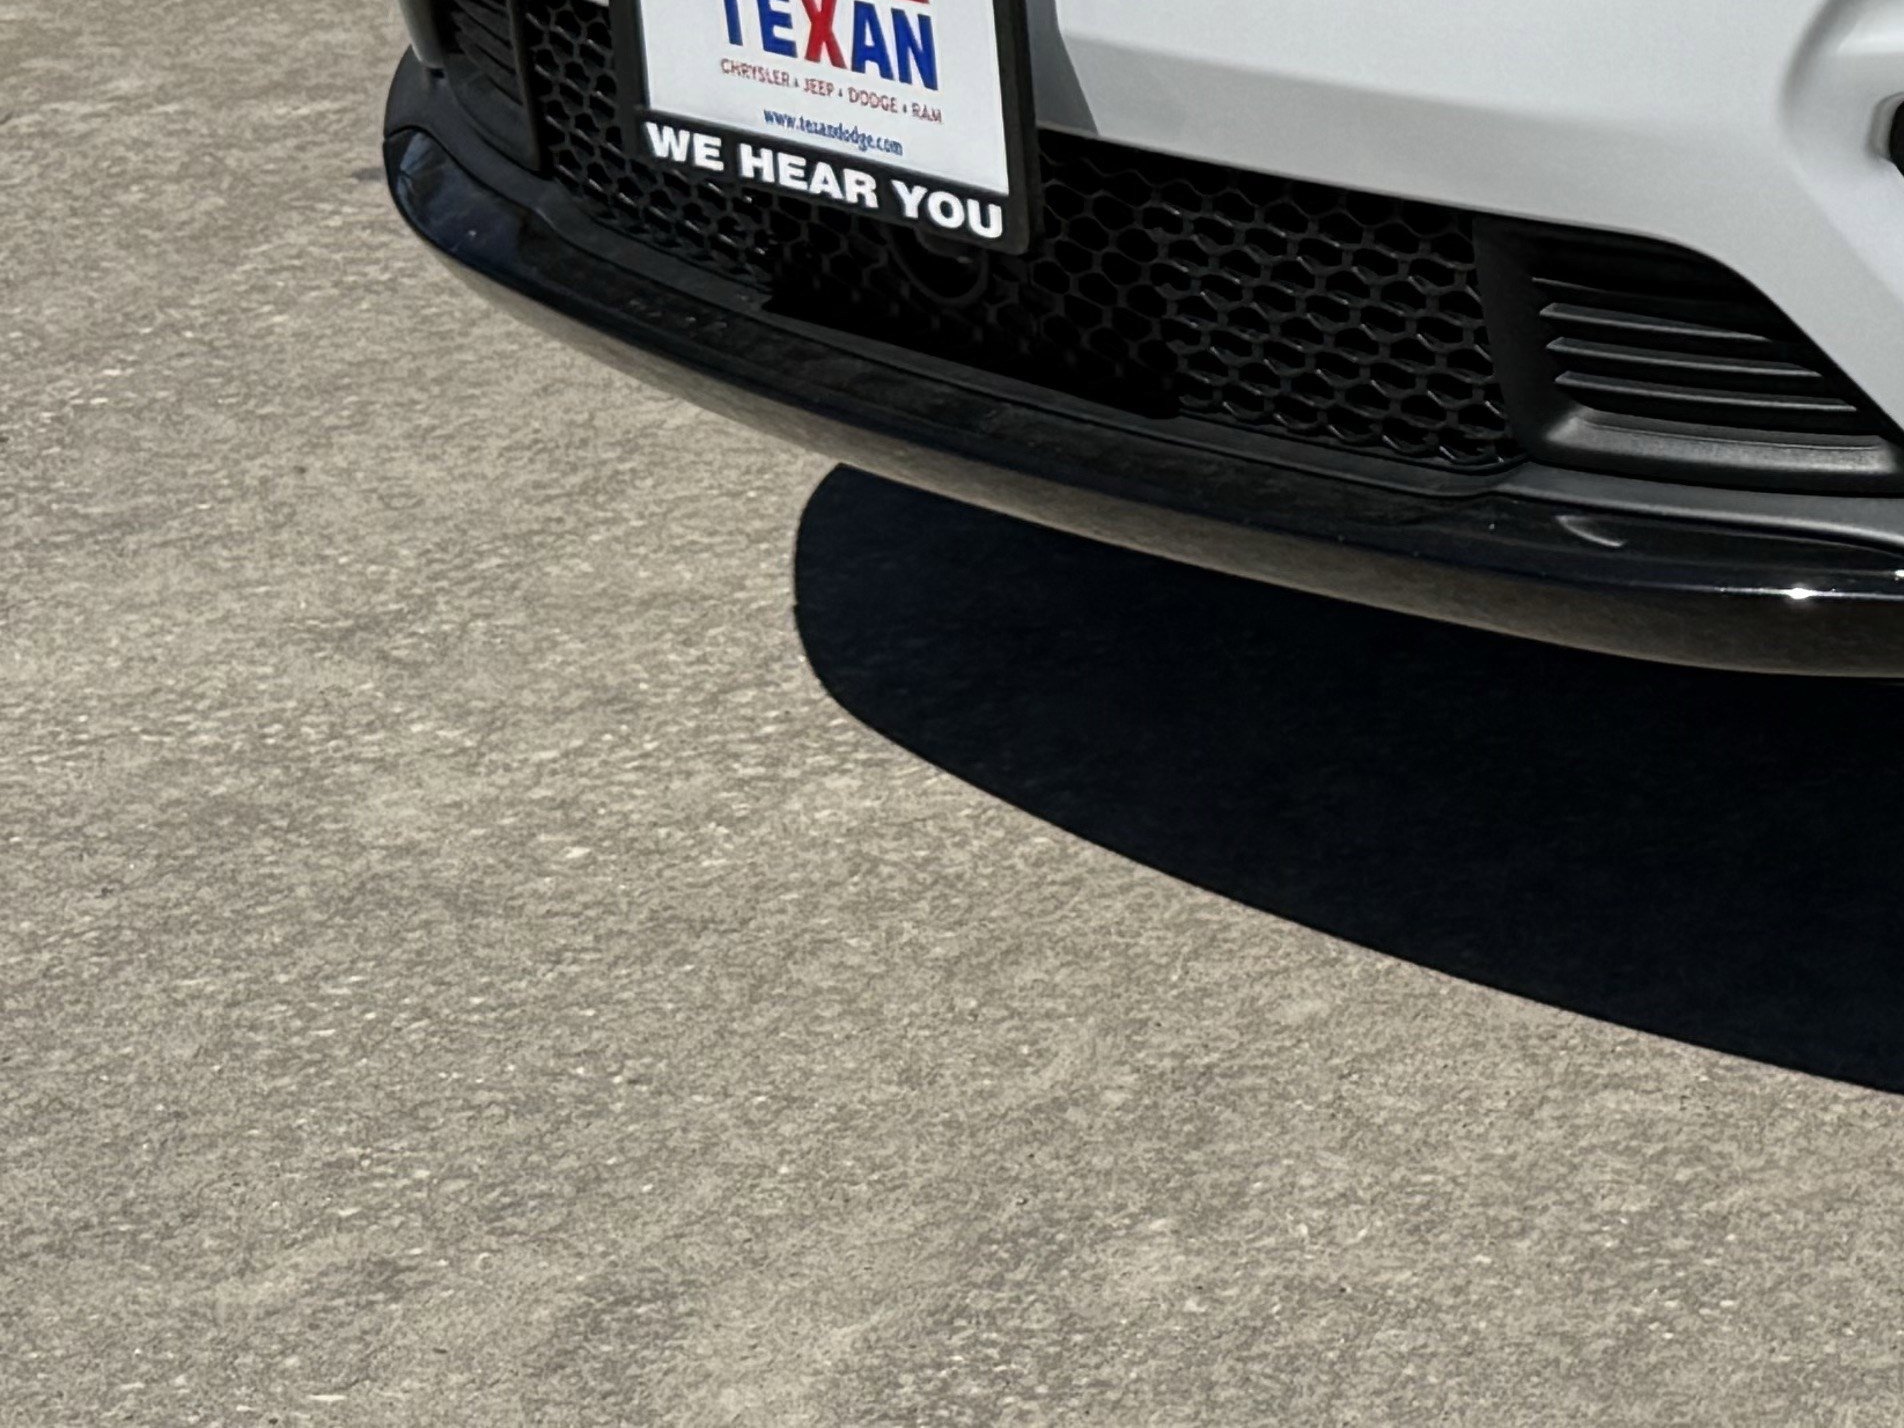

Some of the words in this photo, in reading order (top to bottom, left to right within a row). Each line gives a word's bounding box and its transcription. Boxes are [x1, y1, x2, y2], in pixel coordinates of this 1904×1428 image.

[720, 58, 790, 88] CHRYSLER
[804, 77, 835, 98] JEEP
[848, 86, 899, 114] DODGE
[911, 101, 943, 125] RAM
[763, 108, 904, 157] www.texandodge.com
[645, 121, 725, 172] WE
[738, 143, 879, 209] HEAR
[891, 180, 1004, 240] YOU
